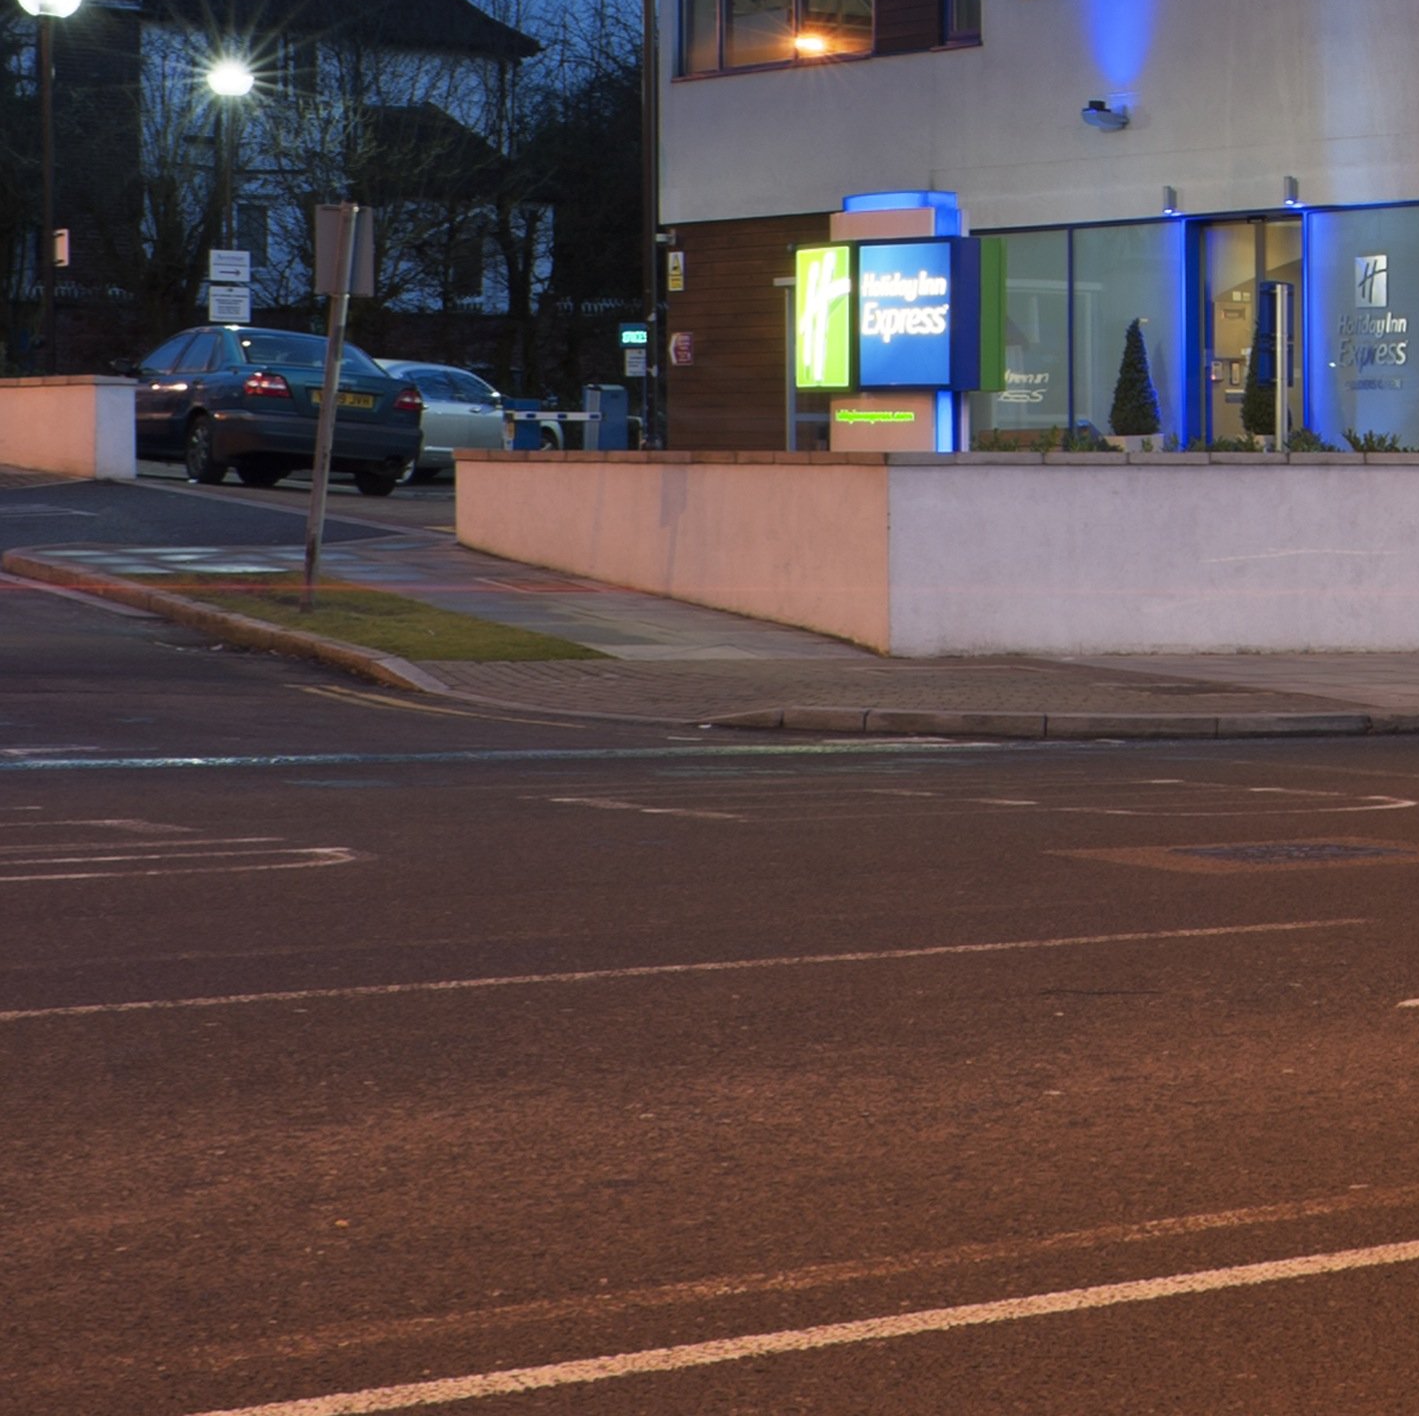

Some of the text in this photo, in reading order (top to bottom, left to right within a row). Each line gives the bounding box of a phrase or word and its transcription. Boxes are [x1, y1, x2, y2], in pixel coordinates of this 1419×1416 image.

[861, 270, 947, 302] Holiday Inn
[861, 302, 947, 343] Express
[1339, 312, 1407, 338] Holiday Inn
[1340, 339, 1406, 373] Express
